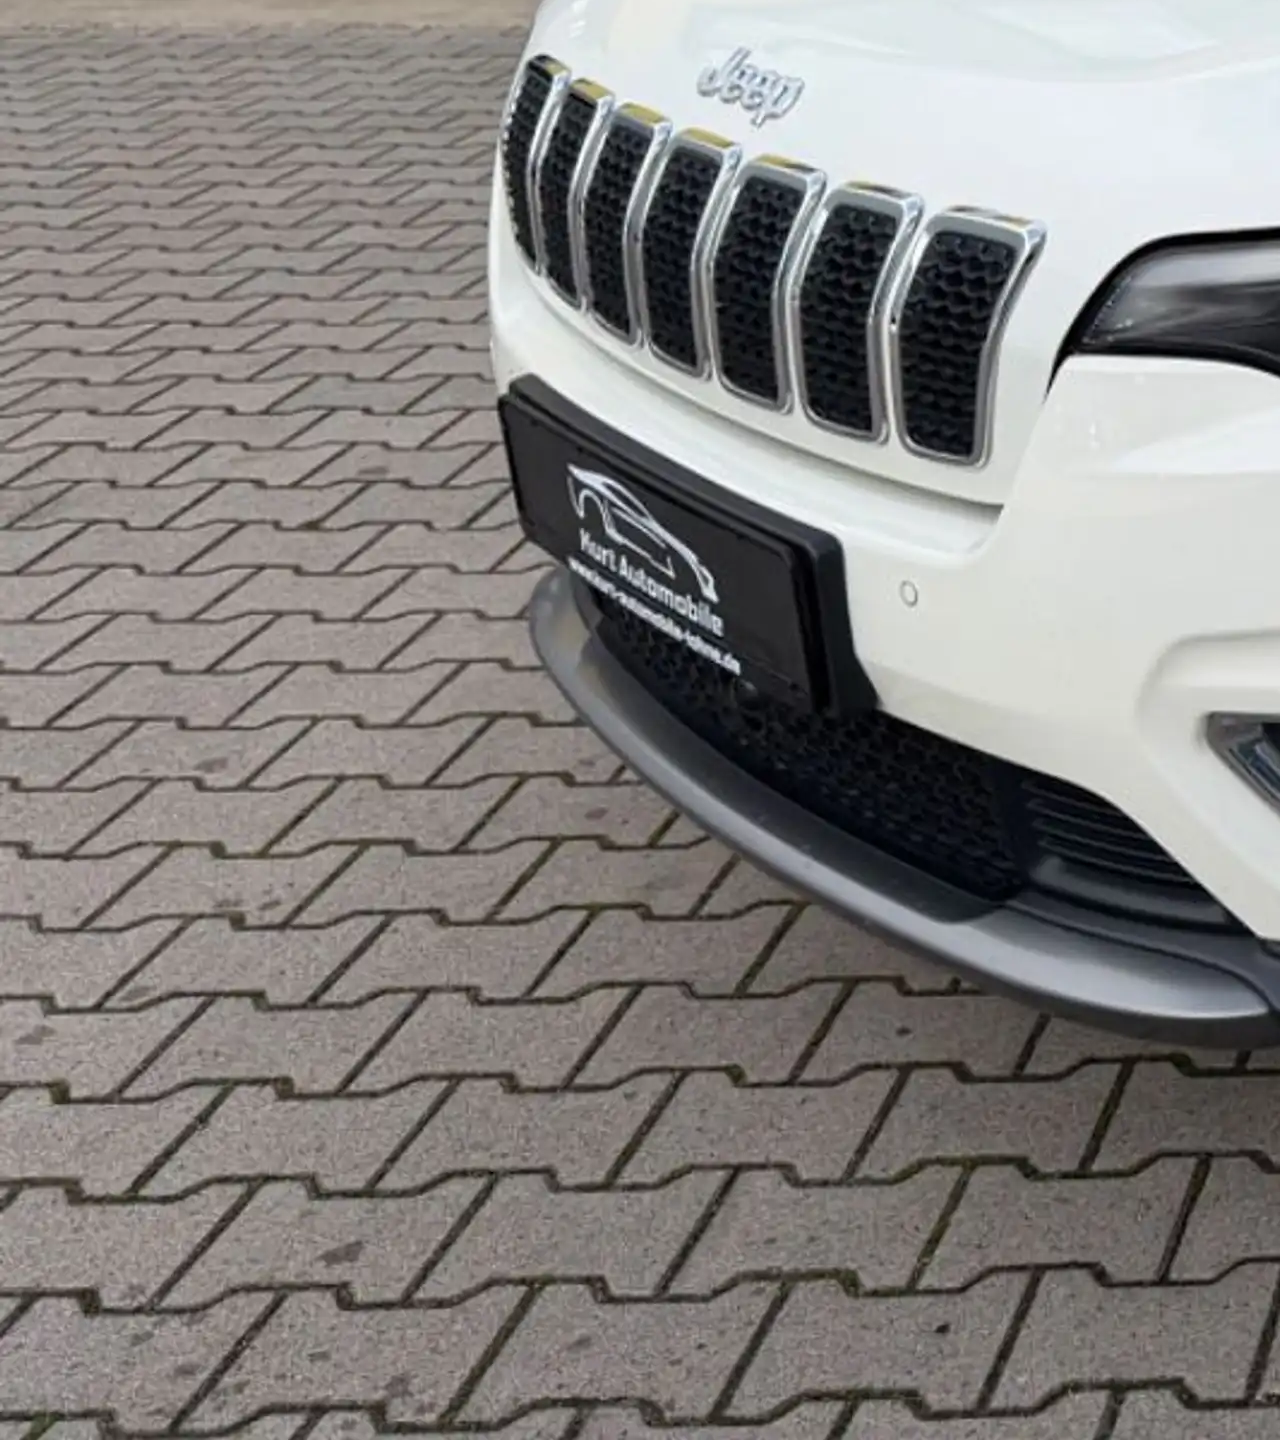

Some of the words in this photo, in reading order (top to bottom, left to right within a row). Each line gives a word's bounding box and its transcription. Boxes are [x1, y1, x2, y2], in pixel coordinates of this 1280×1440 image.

[696, 46, 805, 129] Jeep
[579, 527, 617, 573] Kurt
[618, 554, 726, 638] Automobile
